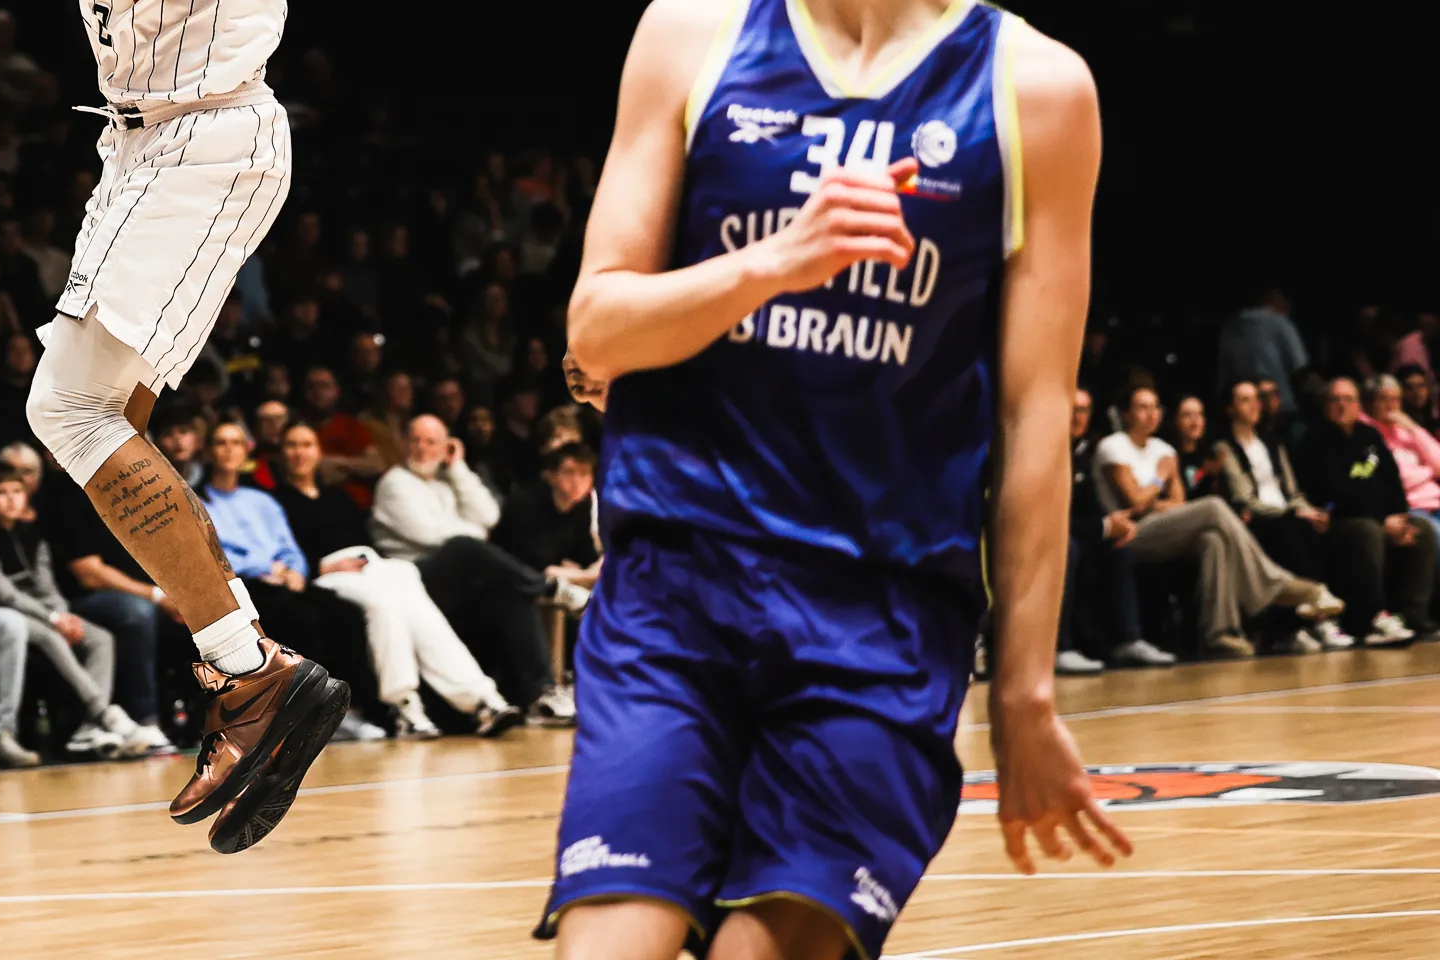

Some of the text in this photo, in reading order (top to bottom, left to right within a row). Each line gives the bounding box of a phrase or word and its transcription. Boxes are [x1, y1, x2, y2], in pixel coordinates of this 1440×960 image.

[790, 115, 895, 193] 34
[766, 304, 913, 367] BRAUN
[129, 459, 152, 474] LORD
